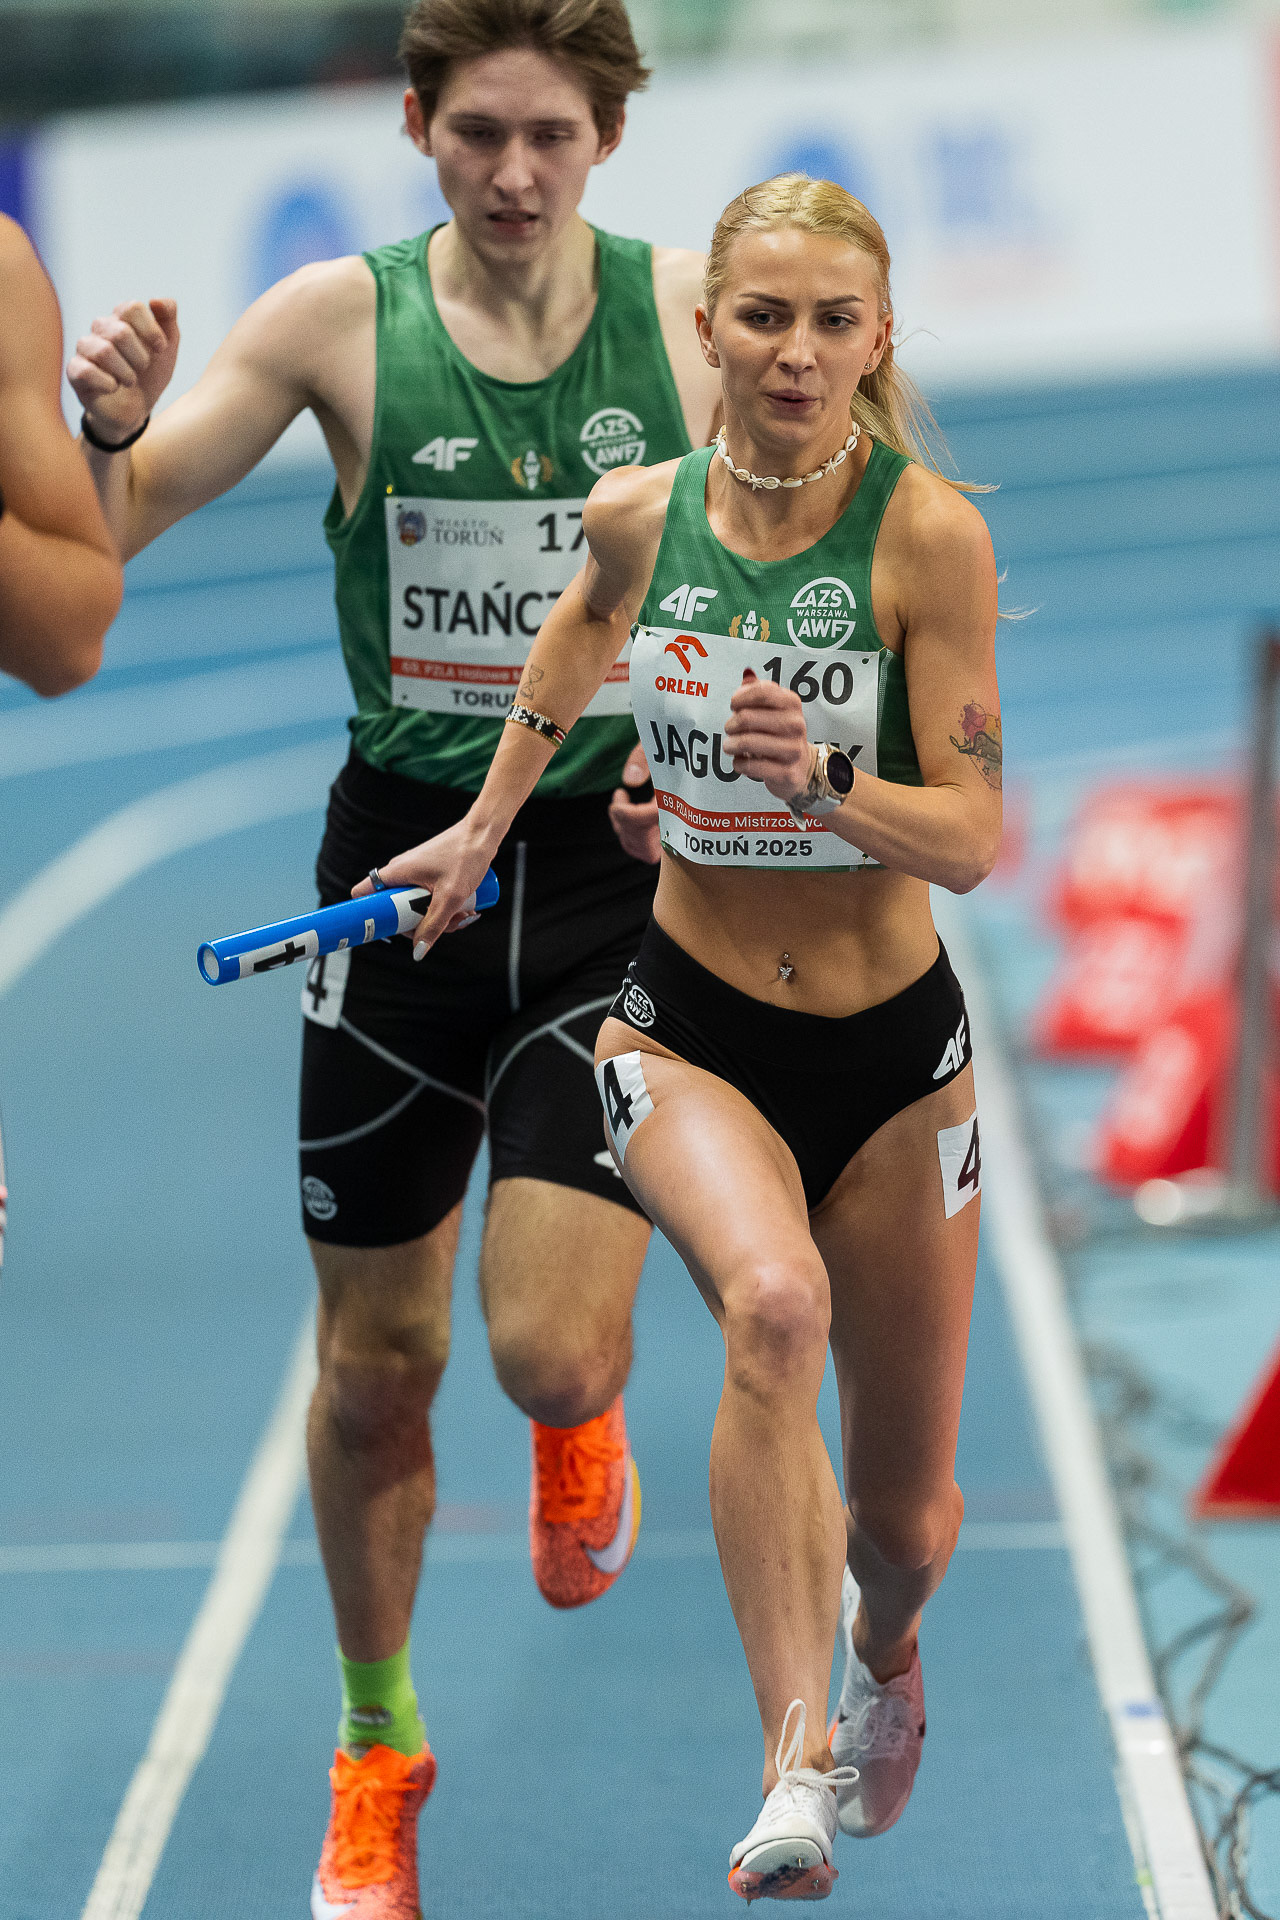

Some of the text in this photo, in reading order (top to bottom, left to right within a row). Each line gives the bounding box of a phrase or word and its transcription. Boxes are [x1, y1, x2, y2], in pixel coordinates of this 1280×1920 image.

[591, 417, 631, 439] AZS
[411, 437, 479, 471] 4F
[595, 443, 637, 465] AWF
[403, 581, 567, 638] STAŃC
[659, 583, 718, 622] 4F
[802, 588, 843, 608] AZS
[796, 609, 848, 618] WARSZAWA
[797, 618, 843, 638] AWF
[655, 675, 709, 698] ORLEN
[763, 656, 853, 706] 160
[452, 689, 516, 708] TORU
[662, 794, 823, 828] 69. PZLA Halowe Mistrzoswa
[684, 831, 813, 857] TORUŃ 2025
[604, 1059, 634, 1137] 4
[957, 1116, 981, 1193] 4
